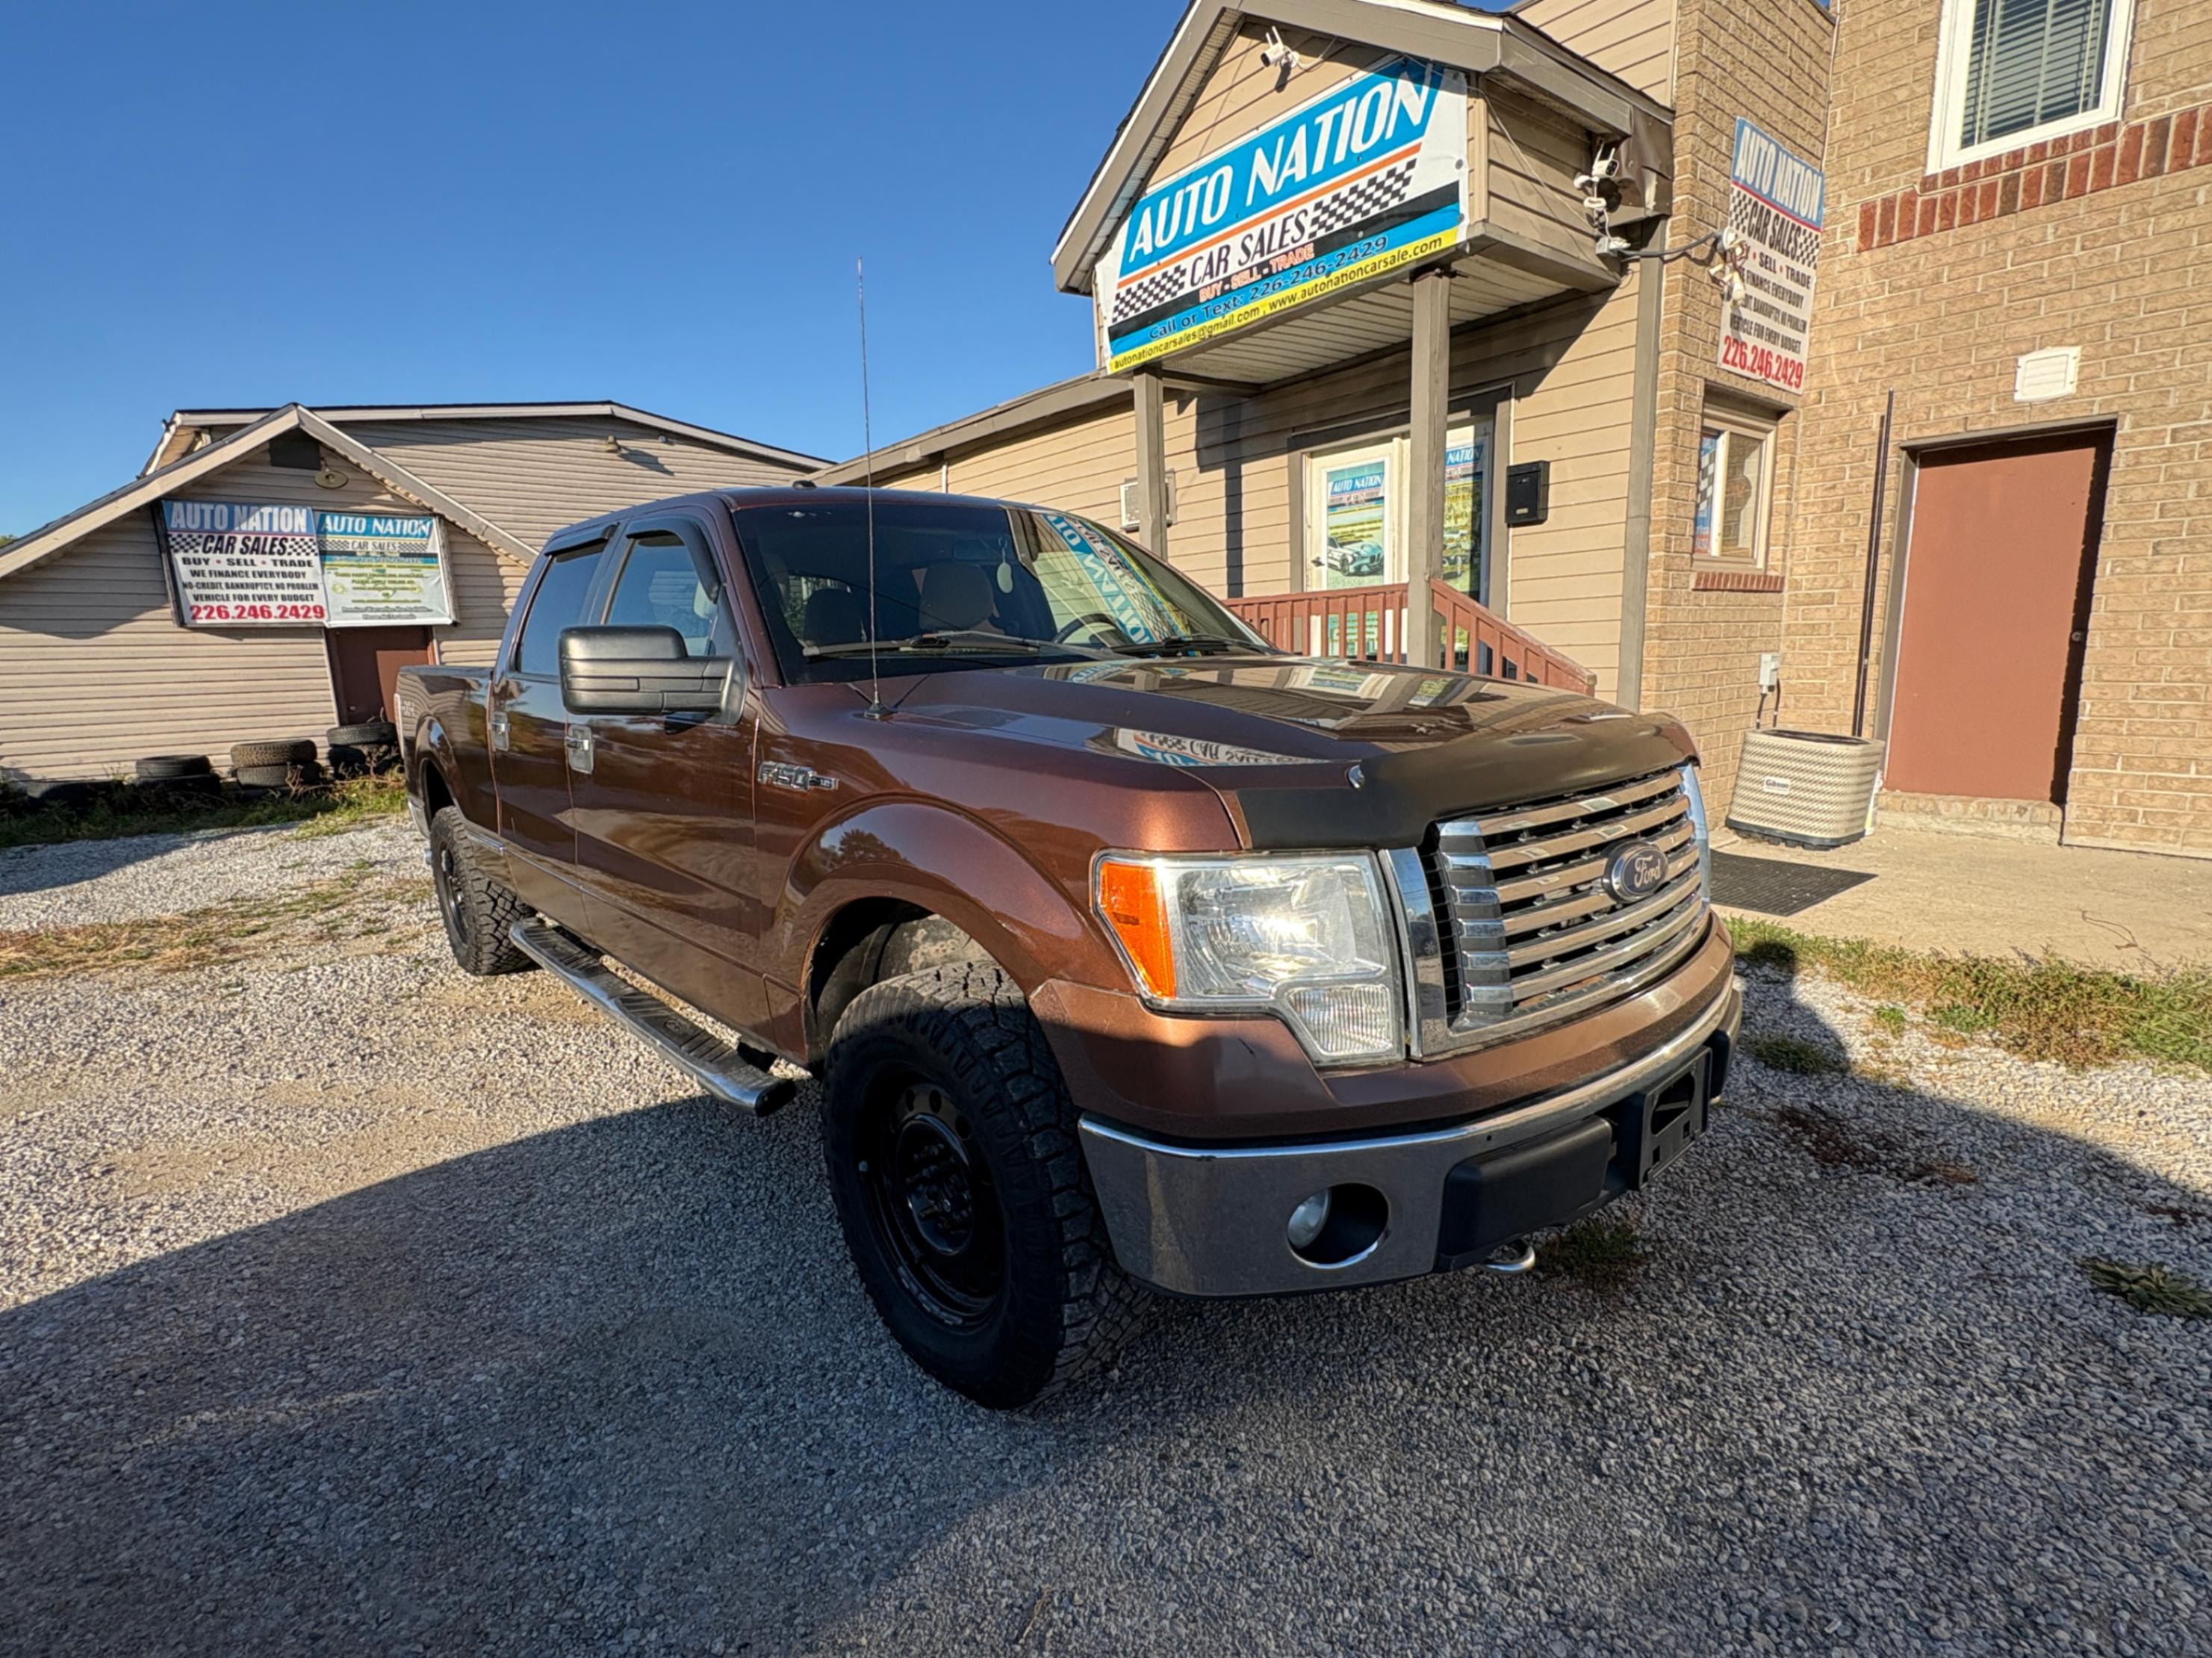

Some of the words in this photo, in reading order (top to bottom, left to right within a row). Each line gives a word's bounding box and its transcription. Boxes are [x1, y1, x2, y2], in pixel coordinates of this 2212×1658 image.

[1129, 165, 1233, 263] AUTO
[1246, 63, 1433, 207] NATION
[1734, 125, 1777, 195] AUTO
[1772, 150, 1822, 222] NATION
[1747, 200, 1771, 246] CAR
[1768, 213, 1802, 261] SALES
[1190, 244, 1231, 287] CAR
[1237, 209, 1308, 266] SALES
[1149, 320, 1176, 340] Call
[1181, 314, 1198, 327] or
[1202, 295, 1245, 319] Text:
[1249, 236, 1388, 300] 226-246-2429
[1199, 280, 1223, 302] BUY
[1231, 267, 1262, 290] SELL
[1270, 243, 1315, 273] TRADE
[1759, 252, 1777, 274] SELL
[1786, 265, 1812, 290] TRADE
[1114, 307, 1260, 369] autonationcarsales@gmail.com
[1268, 237, 1442, 311] www.autonationcarsale.com
[1722, 334, 1804, 389] 226.246.2429
[1332, 479, 1353, 493] AUTO
[1353, 474, 1383, 491] NATION
[170, 501, 229, 530] AUTO
[233, 504, 308, 533] NATION
[321, 515, 366, 533] AUTO
[371, 517, 432, 537] NATION
[201, 534, 237, 555] CAR
[239, 535, 289, 556] SALES
[351, 540, 368, 550] CAR
[372, 541, 397, 551] SALES
[181, 557, 211, 566] BUY
[226, 558, 258, 567] SELL
[270, 559, 314, 568] TRADE
[190, 570, 207, 578] WE
[208, 570, 250, 579] FINANCE
[252, 571, 307, 579] EVERYBODY
[190, 604, 326, 621] 226.246.2429
[193, 594, 231, 602] VEHICLE
[1634, 855, 1662, 889] Ford
